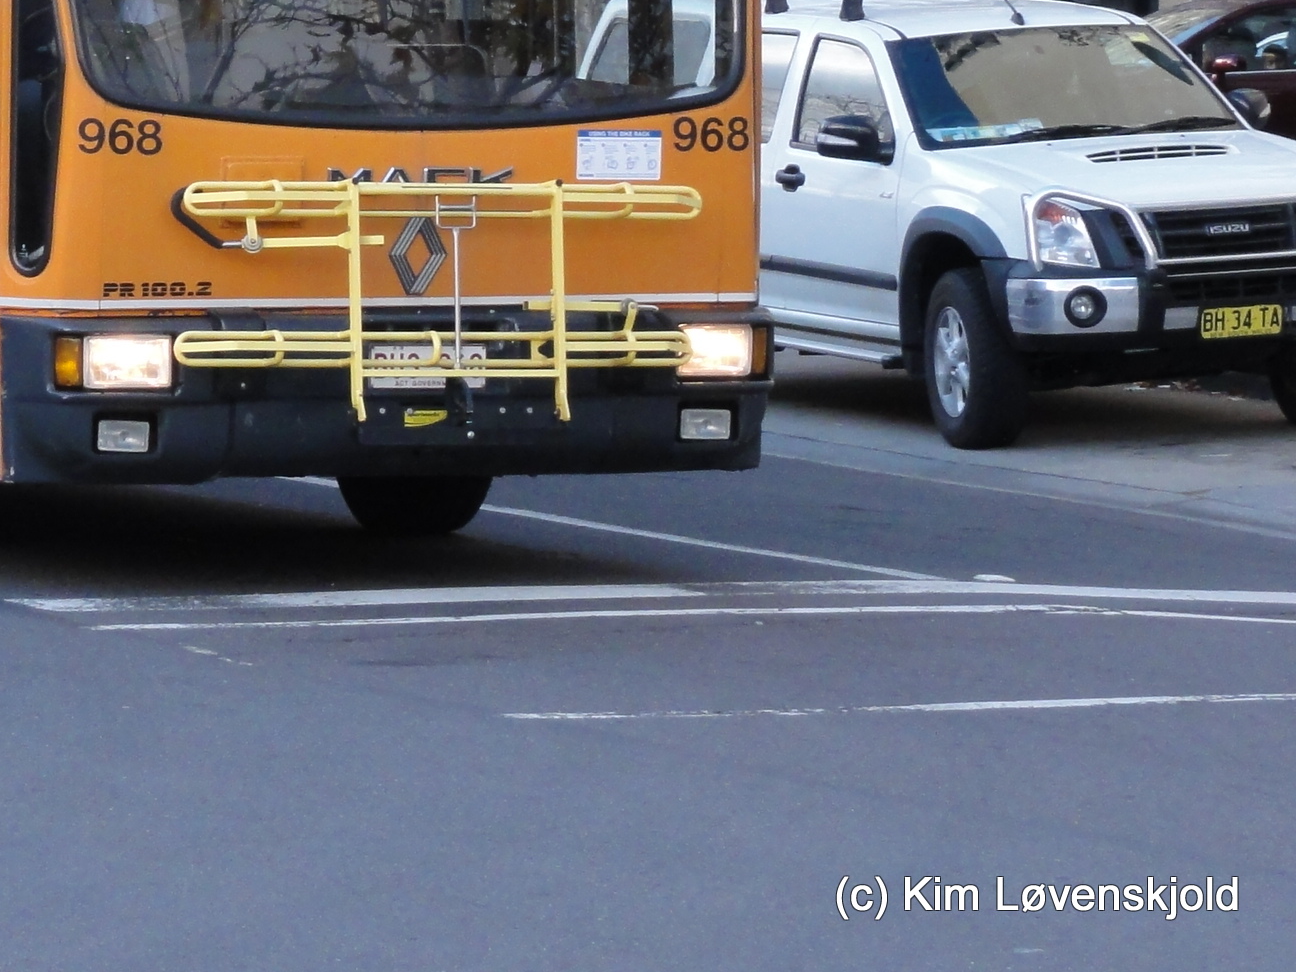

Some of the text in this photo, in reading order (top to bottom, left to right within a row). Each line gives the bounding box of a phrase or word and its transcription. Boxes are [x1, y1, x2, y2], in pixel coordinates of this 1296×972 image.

[77, 117, 163, 156] 968
[672, 116, 750, 153] 968
[1209, 223, 1250, 234] ISUZU
[103, 281, 212, 298] PR 100.2
[1203, 307, 1280, 333] BH 34 TA
